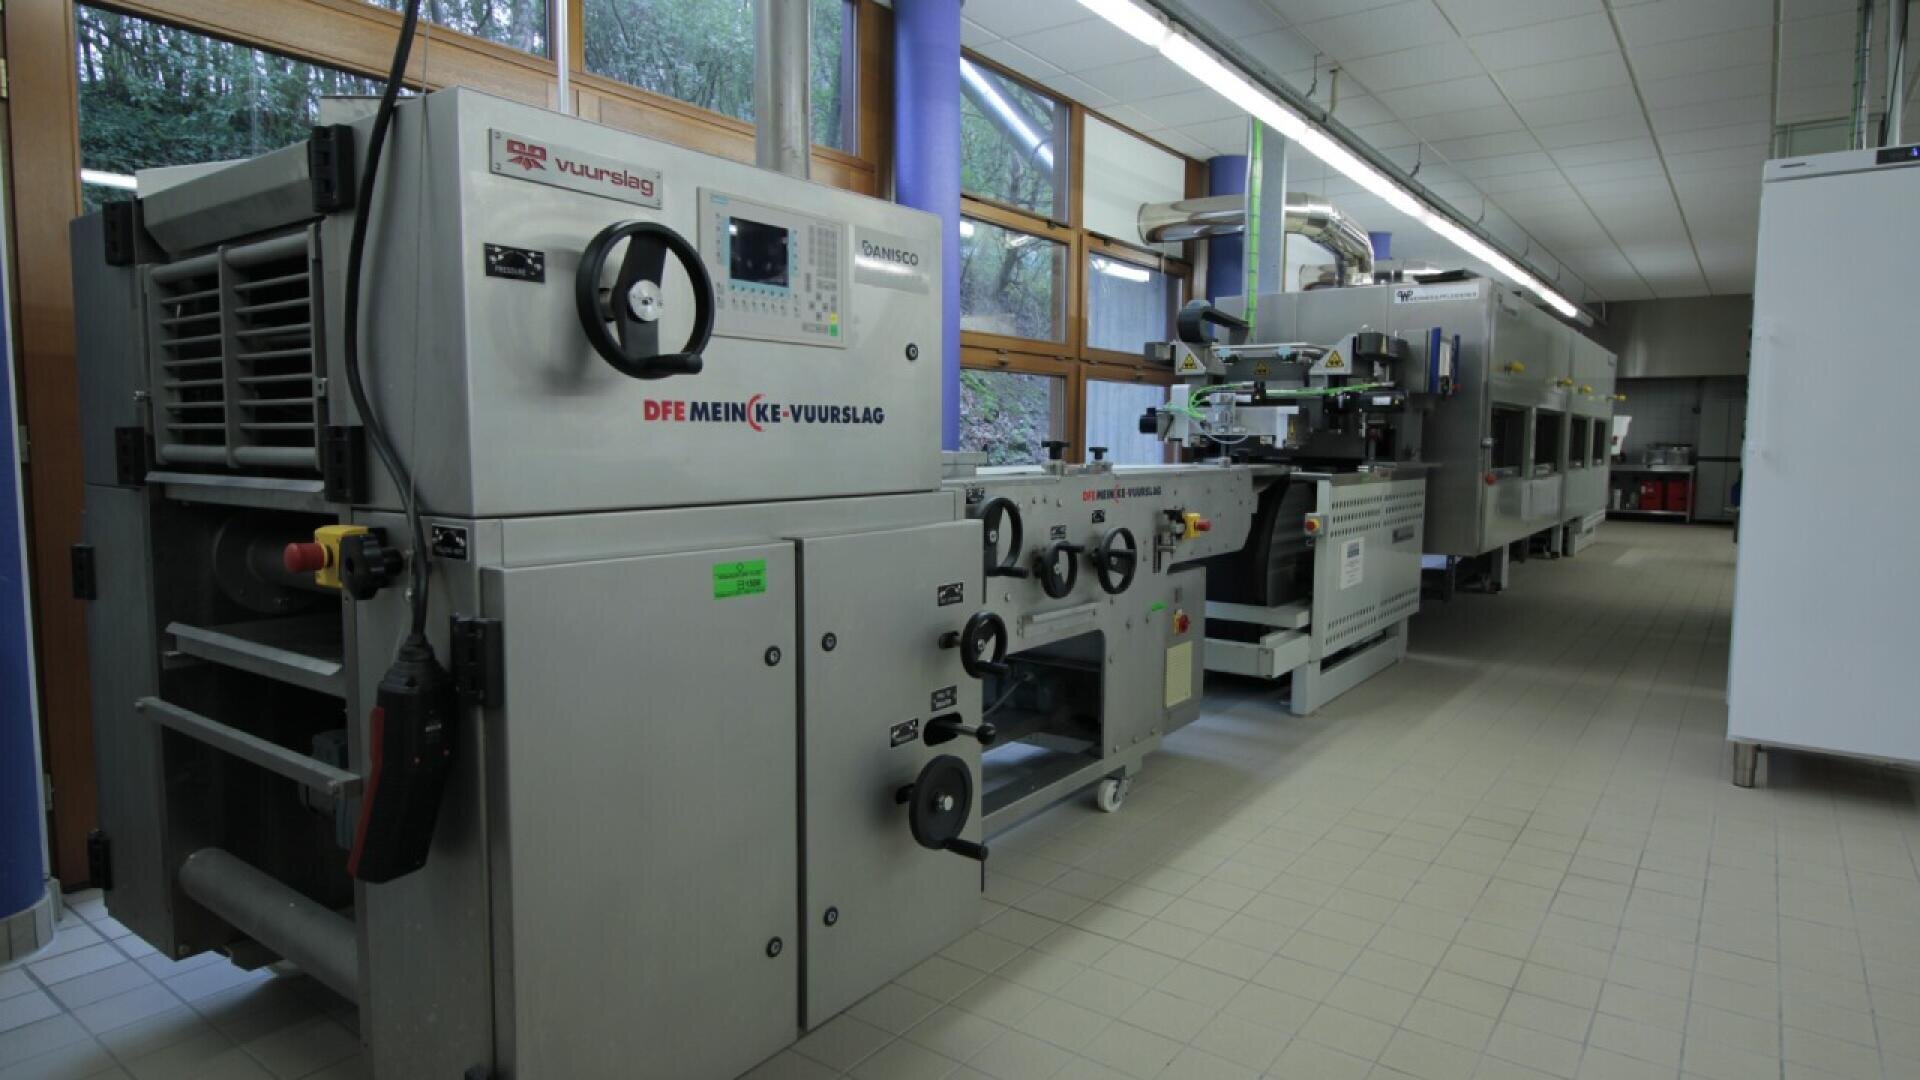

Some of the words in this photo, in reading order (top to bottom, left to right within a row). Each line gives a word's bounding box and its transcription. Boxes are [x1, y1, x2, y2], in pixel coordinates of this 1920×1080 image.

[555, 157, 654, 197] vuurslag
[862, 240, 919, 267] DANISCO
[643, 400, 686, 422] DFE
